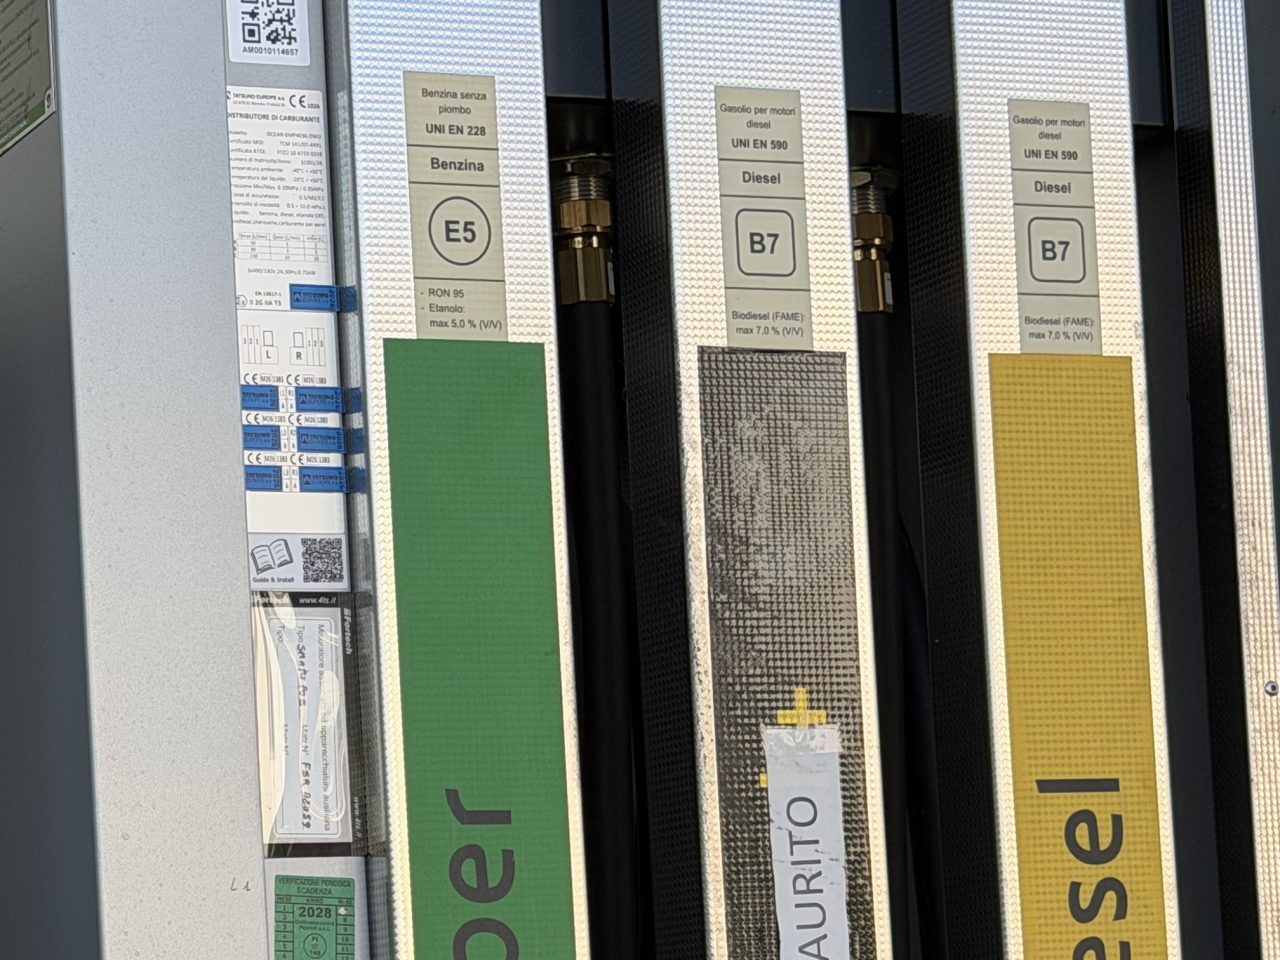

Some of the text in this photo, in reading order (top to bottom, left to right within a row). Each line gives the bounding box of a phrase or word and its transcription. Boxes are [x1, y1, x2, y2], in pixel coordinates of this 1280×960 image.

[242, 46, 298, 56] AM0010114657
[422, 88, 487, 100] Benzina senza
[439, 105, 471, 115] piombo
[720, 103, 796, 116] Gasolio per motori
[280, 115, 320, 123] CARBURANTE
[746, 120, 771, 129] diesel
[1013, 116, 1085, 128] Gasolio per motori
[426, 124, 486, 136] UNI EN 228
[1038, 131, 1062, 140] diesel
[732, 138, 788, 150] UNI EN 590
[1024, 149, 1078, 161] UNI EN 590
[431, 157, 484, 172] Benzina
[742, 171, 781, 184] Diesel
[1034, 180, 1071, 193] Diesel
[444, 220, 477, 243] E5
[749, 232, 780, 254] B7
[1041, 240, 1070, 262] B7
[428, 288, 464, 298] RON 95
[429, 304, 464, 313] Etanolo:
[732, 311, 770, 320] Biodiesel
[1024, 316, 1061, 326] Biodiesel
[430, 319, 502, 331] max 5,0 % (V/V)
[736, 326, 803, 337] max 7,0 % (V/V)
[1048, 330, 1060, 341] 7,0
[1062, 331, 1070, 340] %
[1073, 331, 1093, 342] (V/V)
[266, 350, 271, 359] L
[296, 352, 302, 360] R
[299, 907, 332, 918] 2028
